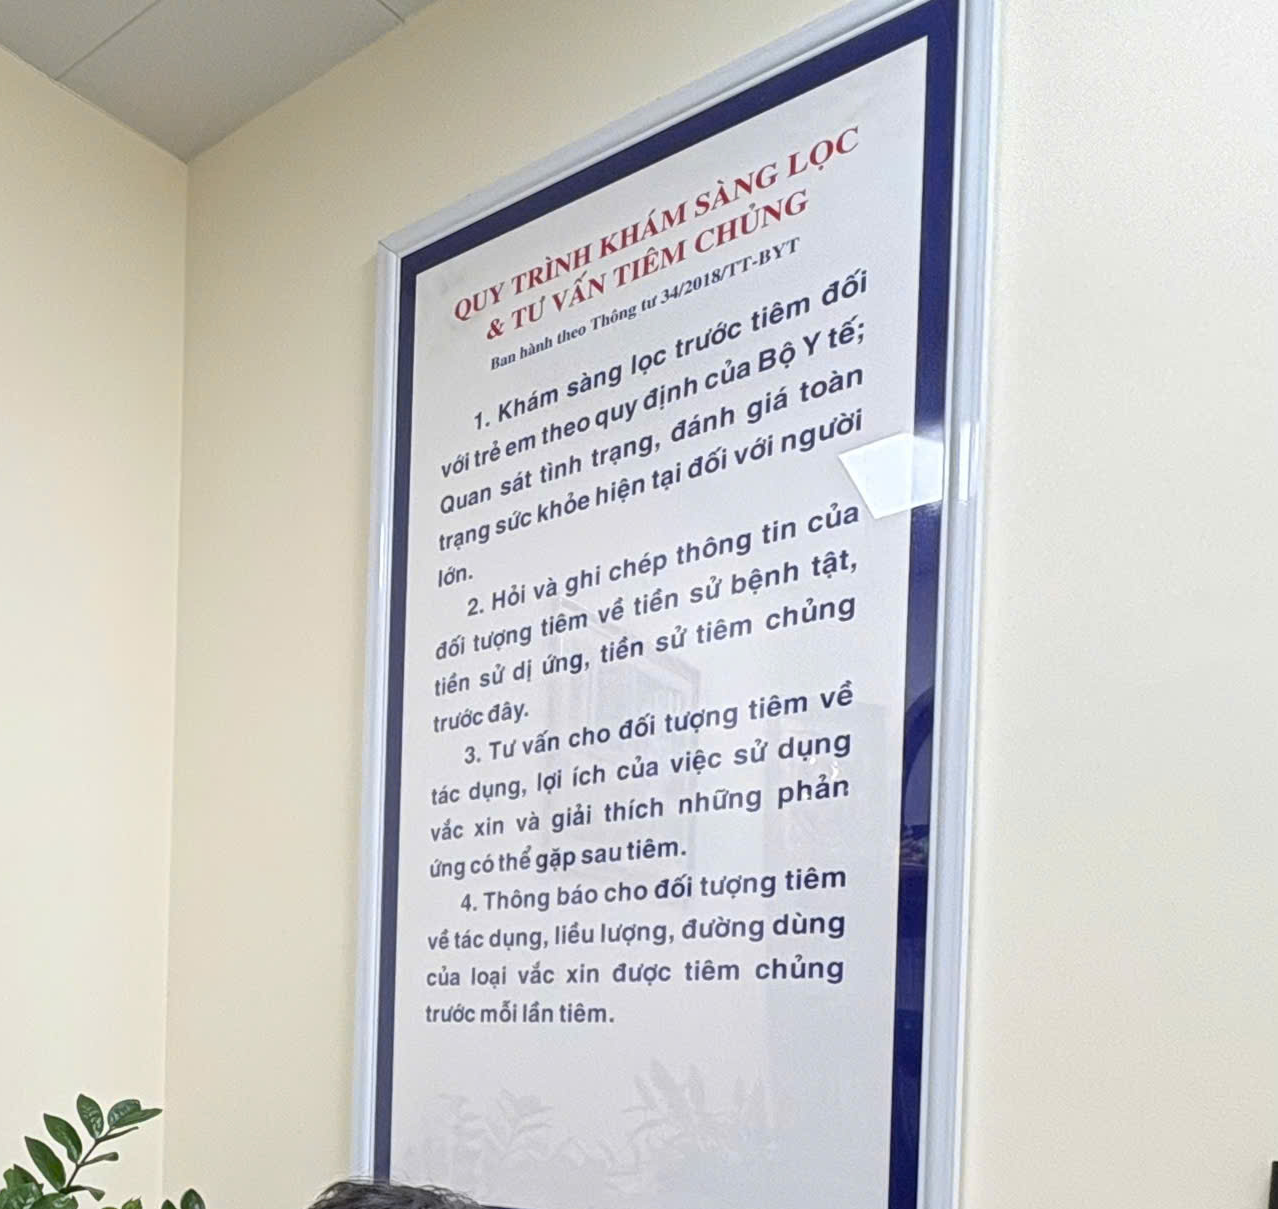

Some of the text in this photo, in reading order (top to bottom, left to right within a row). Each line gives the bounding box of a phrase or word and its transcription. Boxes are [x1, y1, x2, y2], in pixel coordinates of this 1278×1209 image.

[453, 126, 859, 322] QUY TRÌNH KHÁM SÀNG LỌC
[485, 188, 809, 340] & TƯ VẤN TIÊM CHỦNG
[472, 267, 867, 431] 1. Khám sàng lọc trước tiêm đối
[489, 236, 800, 371] Ban hành theo Thông tư 34/2018/TT-BYT
[439, 368, 863, 515] Quan sát tình trạng, đánh giá toàn
[440, 314, 865, 479] với trẻ em theo quy định của Bộ Y tế;
[437, 407, 862, 552] trạng sức khỏe hiện tại đối với người
[434, 549, 857, 661] đối tượng tiêm về tiền sử bệnh tật,
[436, 565, 474, 588] lớn.
[466, 500, 861, 617] 2. Hỏi và ghi chép thông tin của
[433, 597, 856, 697] tiền sử dị ứng, tiền sử tiêm chủng
[430, 733, 851, 806] tác dụng, lợi ích của việc sử dụng
[432, 701, 529, 734] trước đây.
[463, 679, 853, 765] 3. Tư vấn cho đối tượng tiêm về
[429, 773, 849, 842] vắc xin và giải thích những phản
[426, 911, 845, 951] về tác dụng, liều lượng, đường dùng
[459, 866, 847, 913] 4. Thông báo cho đối tượng tiêm
[424, 999, 615, 1024] trước mỗi lần tiêm.
